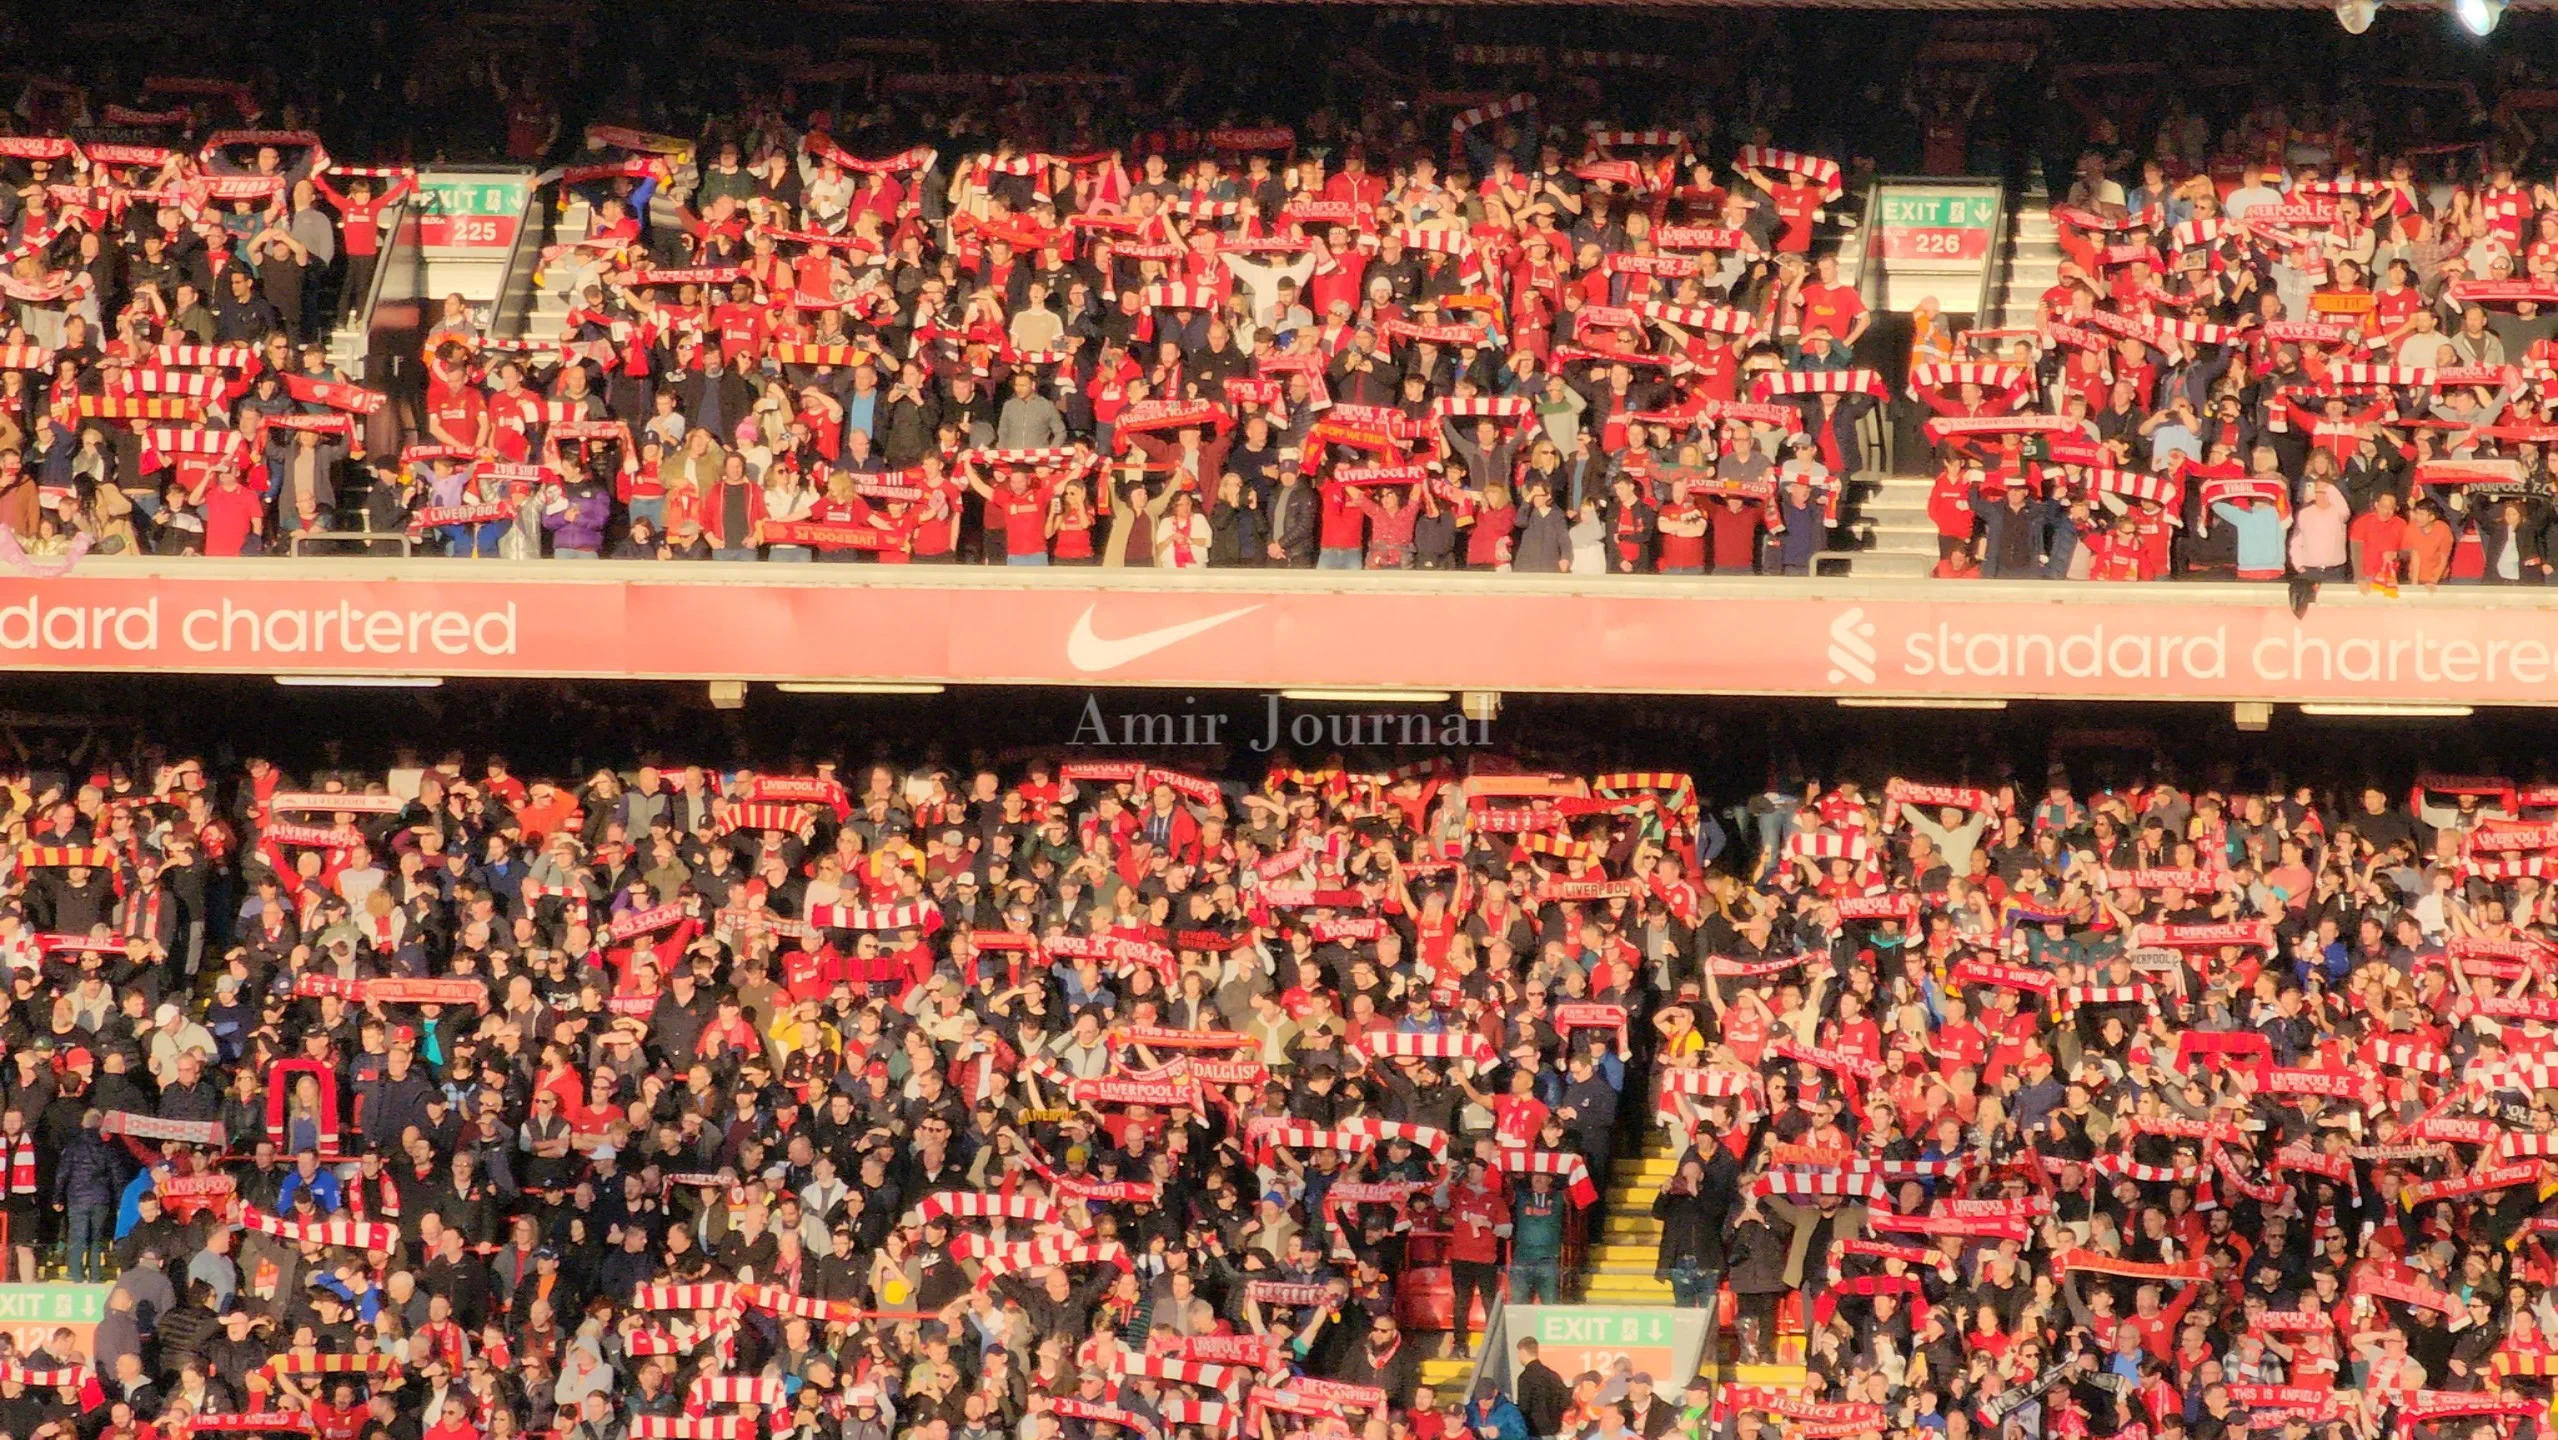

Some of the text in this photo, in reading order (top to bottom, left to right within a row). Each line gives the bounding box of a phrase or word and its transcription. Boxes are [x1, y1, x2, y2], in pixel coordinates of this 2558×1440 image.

[1288, 202, 1351, 213] LIVERPOOL
[1883, 202, 1940, 222] EXIT
[454, 222, 497, 241] 225
[1657, 230, 1731, 242] LIVERPOOL FC
[1915, 234, 1960, 254] 226
[1617, 256, 1676, 268] LIVERPOOL
[2318, 325, 2342, 337] MO
[1335, 466, 1421, 482] LIVERPOOL FC
[2223, 483, 2253, 493] VIRGIL
[430, 504, 499, 521] LIVERPOOL
[813, 529, 877, 545] LIVERPOOL
[0, 596, 517, 655] dard chartered
[1904, 620, 2226, 680] standard
[762, 781, 827, 792] LIVERPOOL FC
[1891, 783, 1949, 799] LIVERPOOL
[307, 798, 367, 806] LIVERPOOL
[2478, 830, 2540, 845] LIVERPOOL
[2135, 871, 2211, 883] LIVERPOOL FC
[1565, 883, 1628, 896] LIVERPOOL
[1839, 898, 1891, 910] LIVERPOOL
[612, 906, 682, 936] MO SALAH
[2174, 926, 2248, 937] LIVERPOOL FC
[1967, 963, 2048, 986] THIS IS ANFIELD
[2481, 997, 2530, 1011] LIVERPOOL
[1795, 1042, 1862, 1070] LIVERPOOL
[2270, 1072, 2351, 1089] LIVERPOOL FC
[1099, 1083, 1191, 1096] LIVERPOOL FC
[2424, 1119, 2480, 1133] LIVERPOOL
[2277, 1147, 2325, 1165] LIVERPOOL
[168, 1177, 228, 1194] LIVERPOO
[2441, 1165, 2532, 1192] THIS IS ANFIELD
[1952, 1200, 2006, 1212] LIVERPOOL
[0, 1294, 44, 1316] XIT
[1544, 1318, 1612, 1341] EXIT
[2233, 1387, 2322, 1404] THIS IS ANFIELD
[1768, 1396, 1837, 1419] JUSTICE
[197, 1414, 289, 1425] THIS IS ANFIELD
[1804, 1418, 1884, 1437] LIVERPOOL
